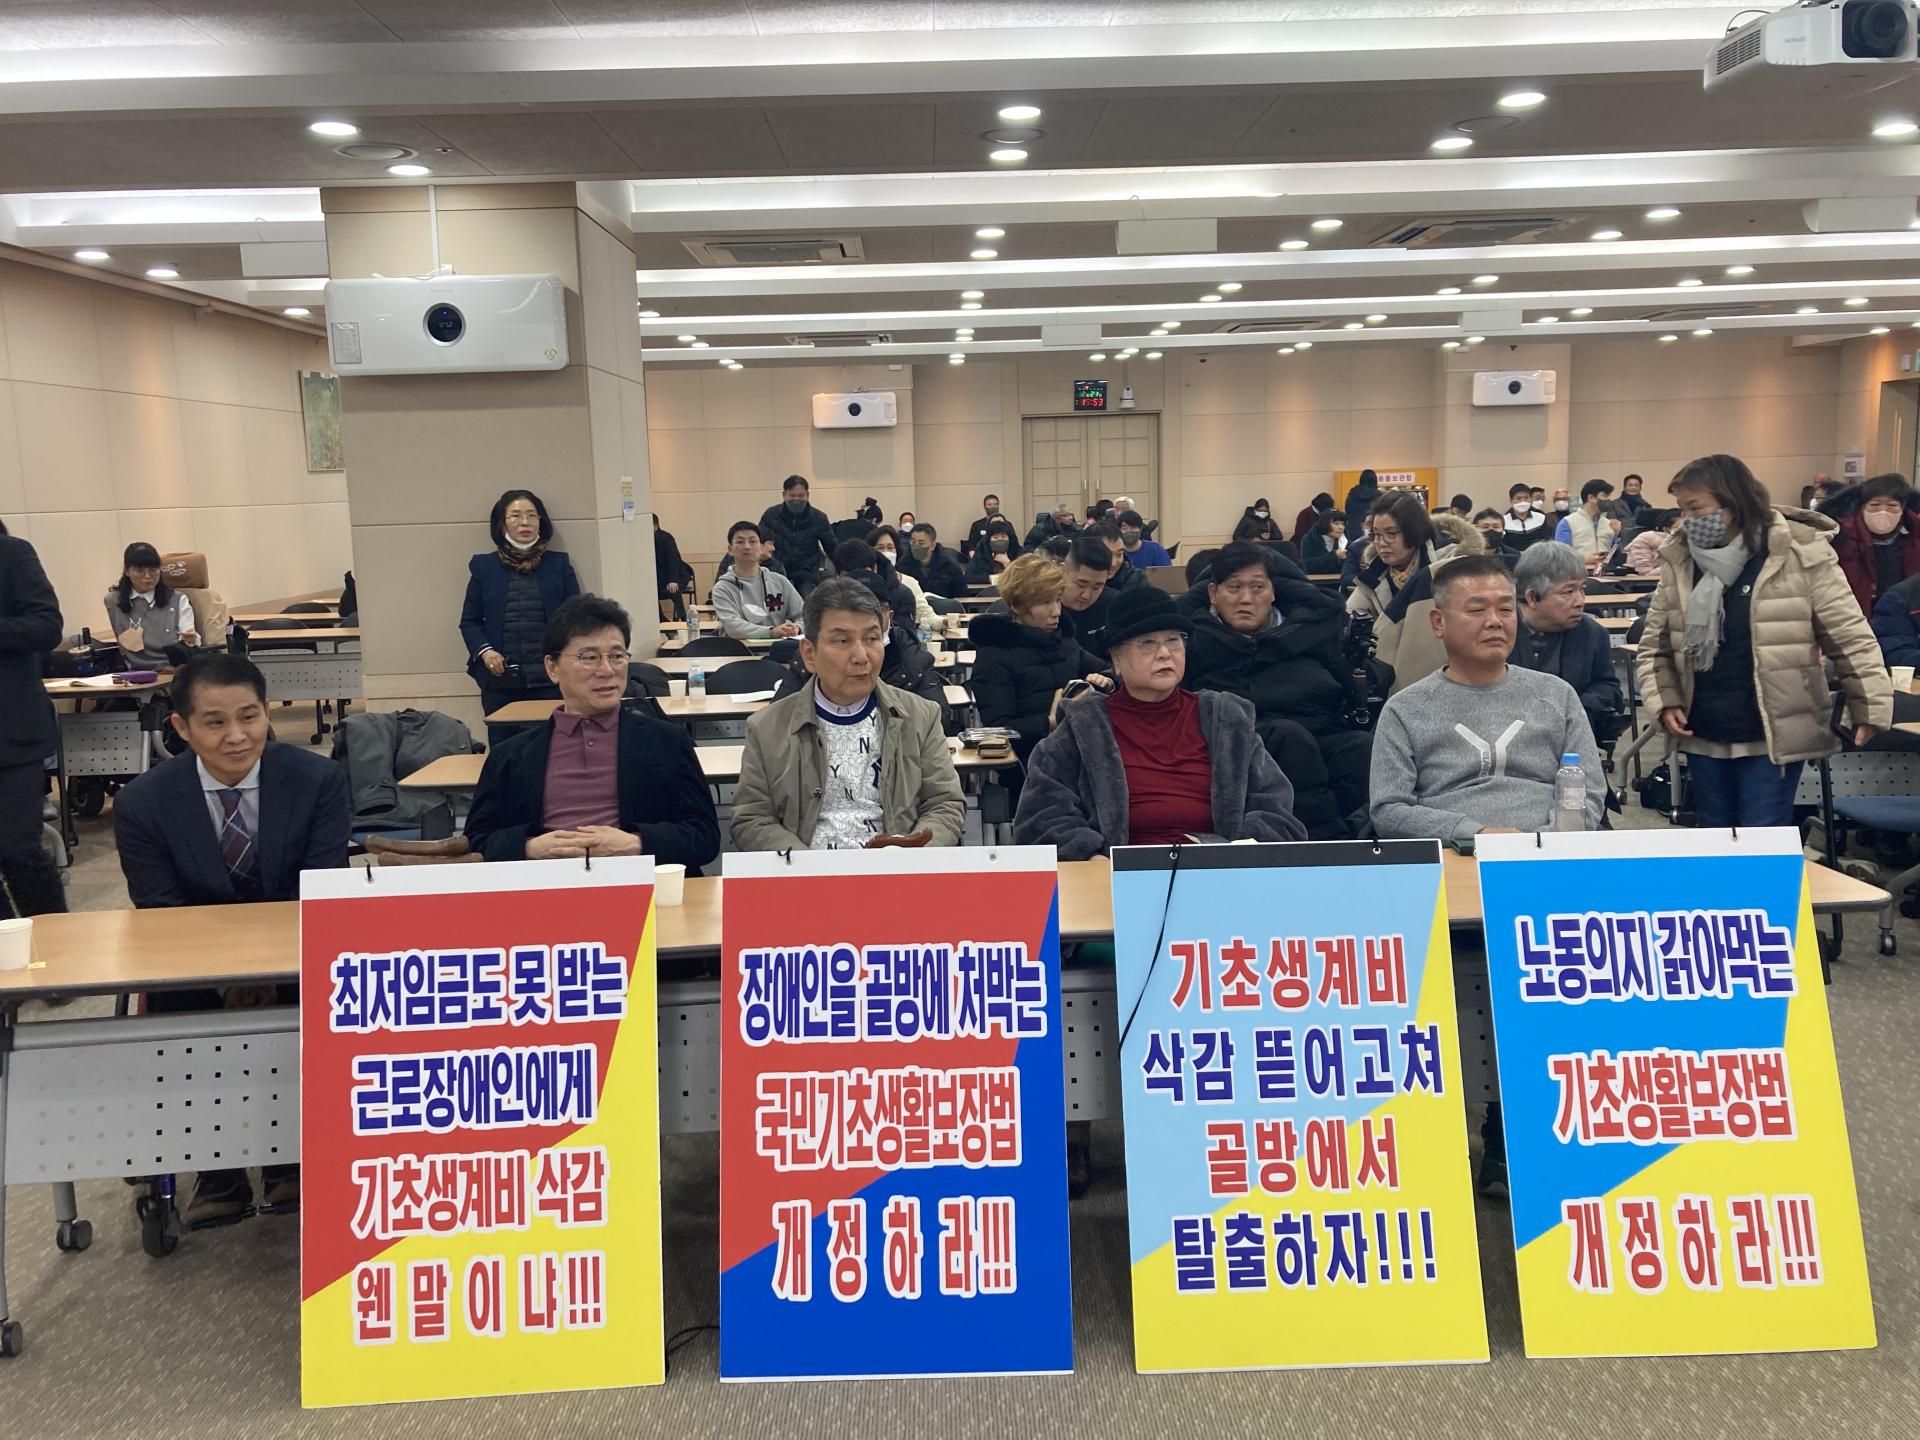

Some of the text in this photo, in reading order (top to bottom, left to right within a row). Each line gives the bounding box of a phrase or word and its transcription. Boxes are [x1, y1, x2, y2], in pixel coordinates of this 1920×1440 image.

[830, 764, 840, 778] Y
[859, 737, 870, 754] N
[335, 946, 624, 1028] 최저임금도 못 받는
[741, 946, 1043, 1042] 장애인을 골방에 처박는
[1169, 936, 1408, 1010] 기초생계비
[1520, 913, 1794, 999] 노동의지 갉아먹는
[356, 1047, 593, 1131] 근로장애인에게
[1142, 1024, 1444, 1102] 삭감 뜯어고쳐
[1552, 1052, 1793, 1141] 기초생활보장법
[759, 1069, 1017, 1167] 국민기초생활보장법
[1206, 1117, 1399, 1195] 골방에서
[354, 1149, 606, 1236] 기초생계비 삭감
[1173, 1210, 1437, 1291] 탈출하자!!!
